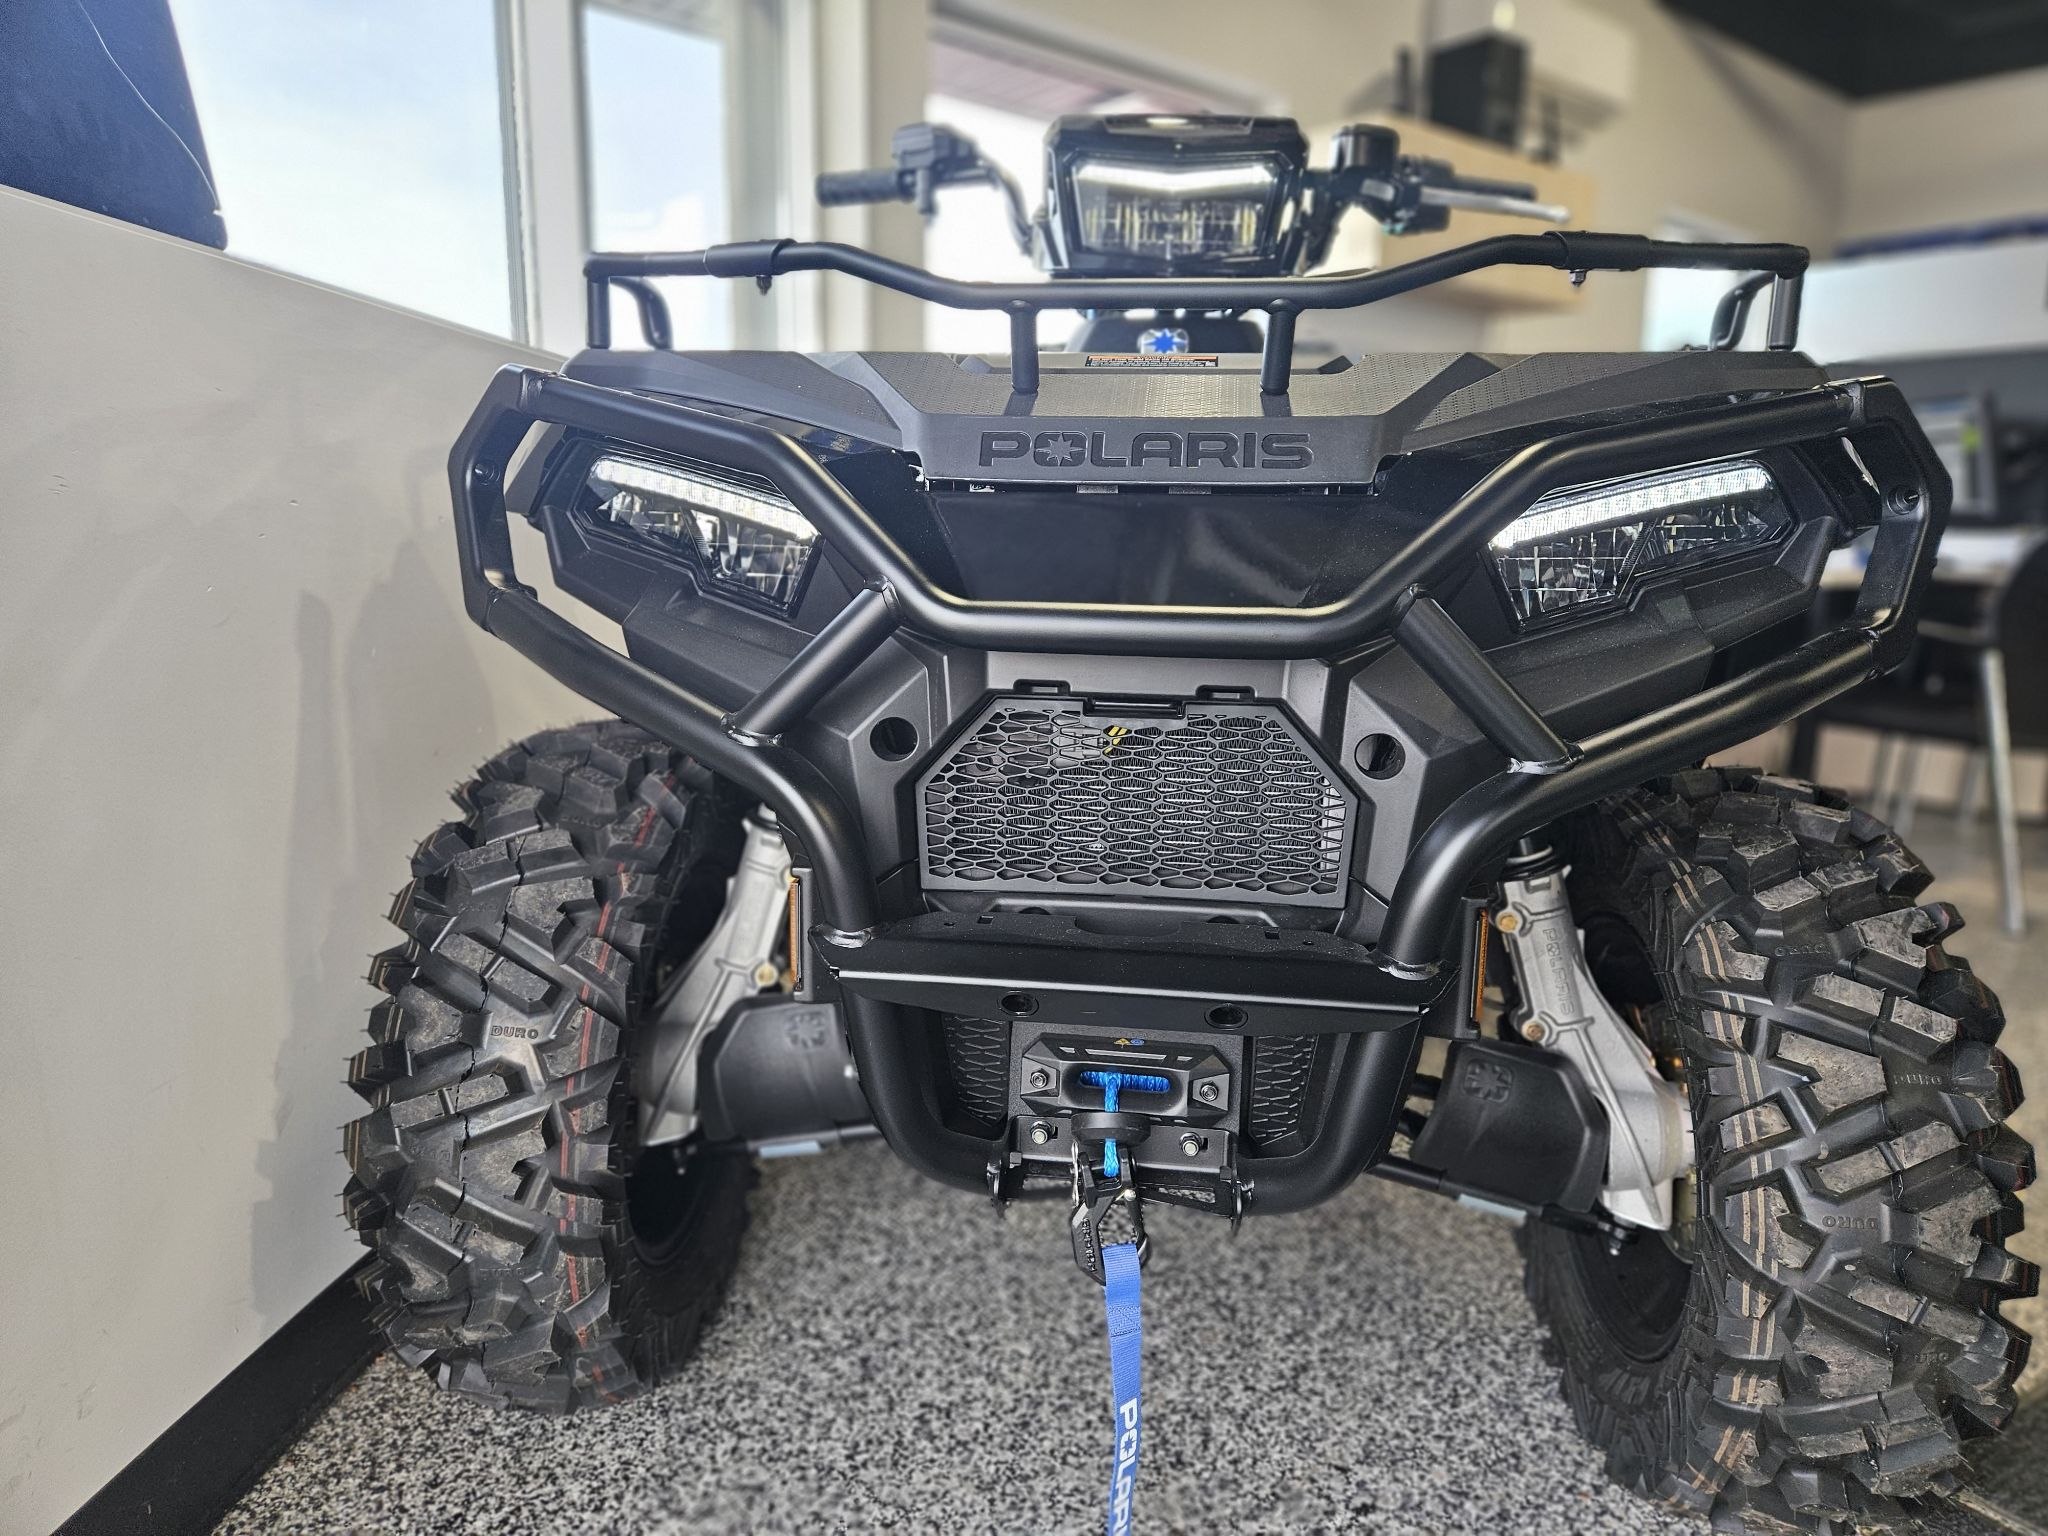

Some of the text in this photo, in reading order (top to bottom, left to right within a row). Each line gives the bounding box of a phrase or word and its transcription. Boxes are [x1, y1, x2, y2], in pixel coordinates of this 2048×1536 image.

[979, 430, 1315, 470] POLARIS
[1542, 927, 1575, 1016] POLARIS
[490, 1025, 539, 1040] DURO
[1822, 1215, 1879, 1229] DURO
